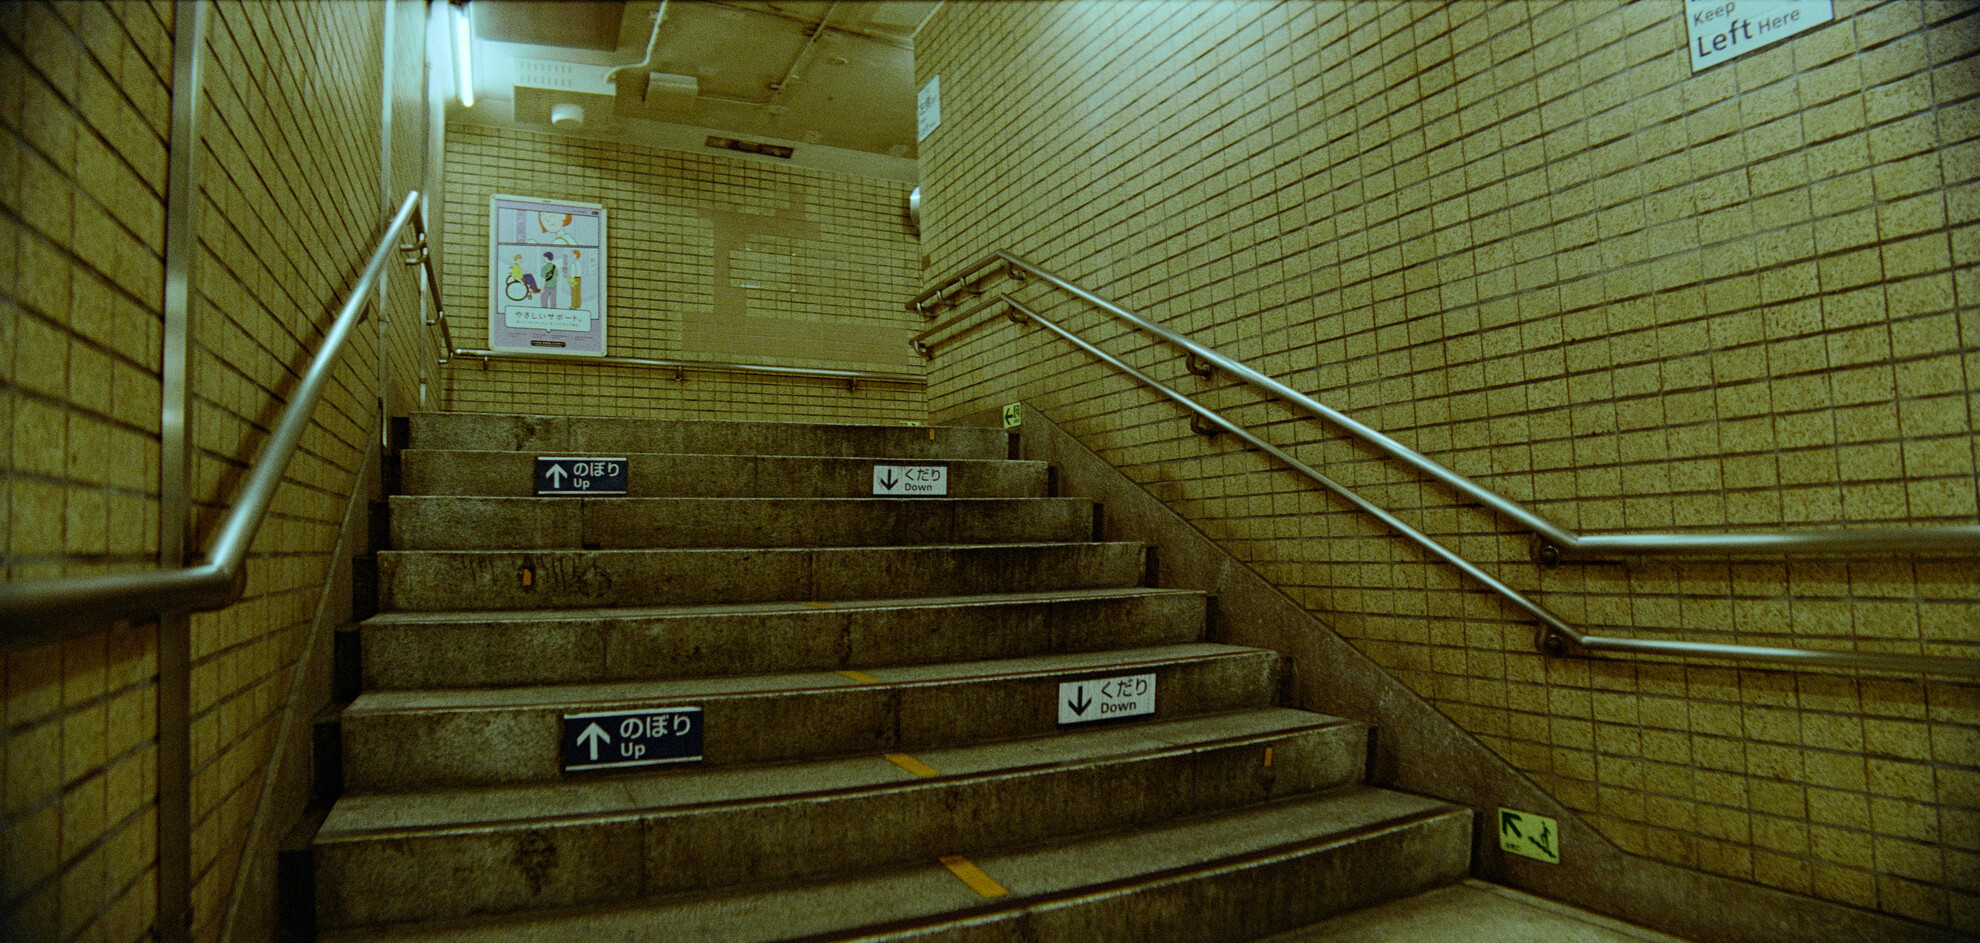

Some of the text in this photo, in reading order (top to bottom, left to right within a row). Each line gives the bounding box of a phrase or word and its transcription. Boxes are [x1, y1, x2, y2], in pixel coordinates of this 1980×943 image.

[1693, 1, 1736, 27] Keep
[1697, 9, 1800, 57] Left Here
[573, 462, 620, 477] のぼり
[905, 468, 941, 482] くだり
[573, 478, 591, 490] Up
[904, 482, 933, 491] Down
[1101, 678, 1148, 699] くだり
[1100, 701, 1137, 714] Down
[620, 714, 691, 739] のぼり
[620, 741, 646, 760] Up
